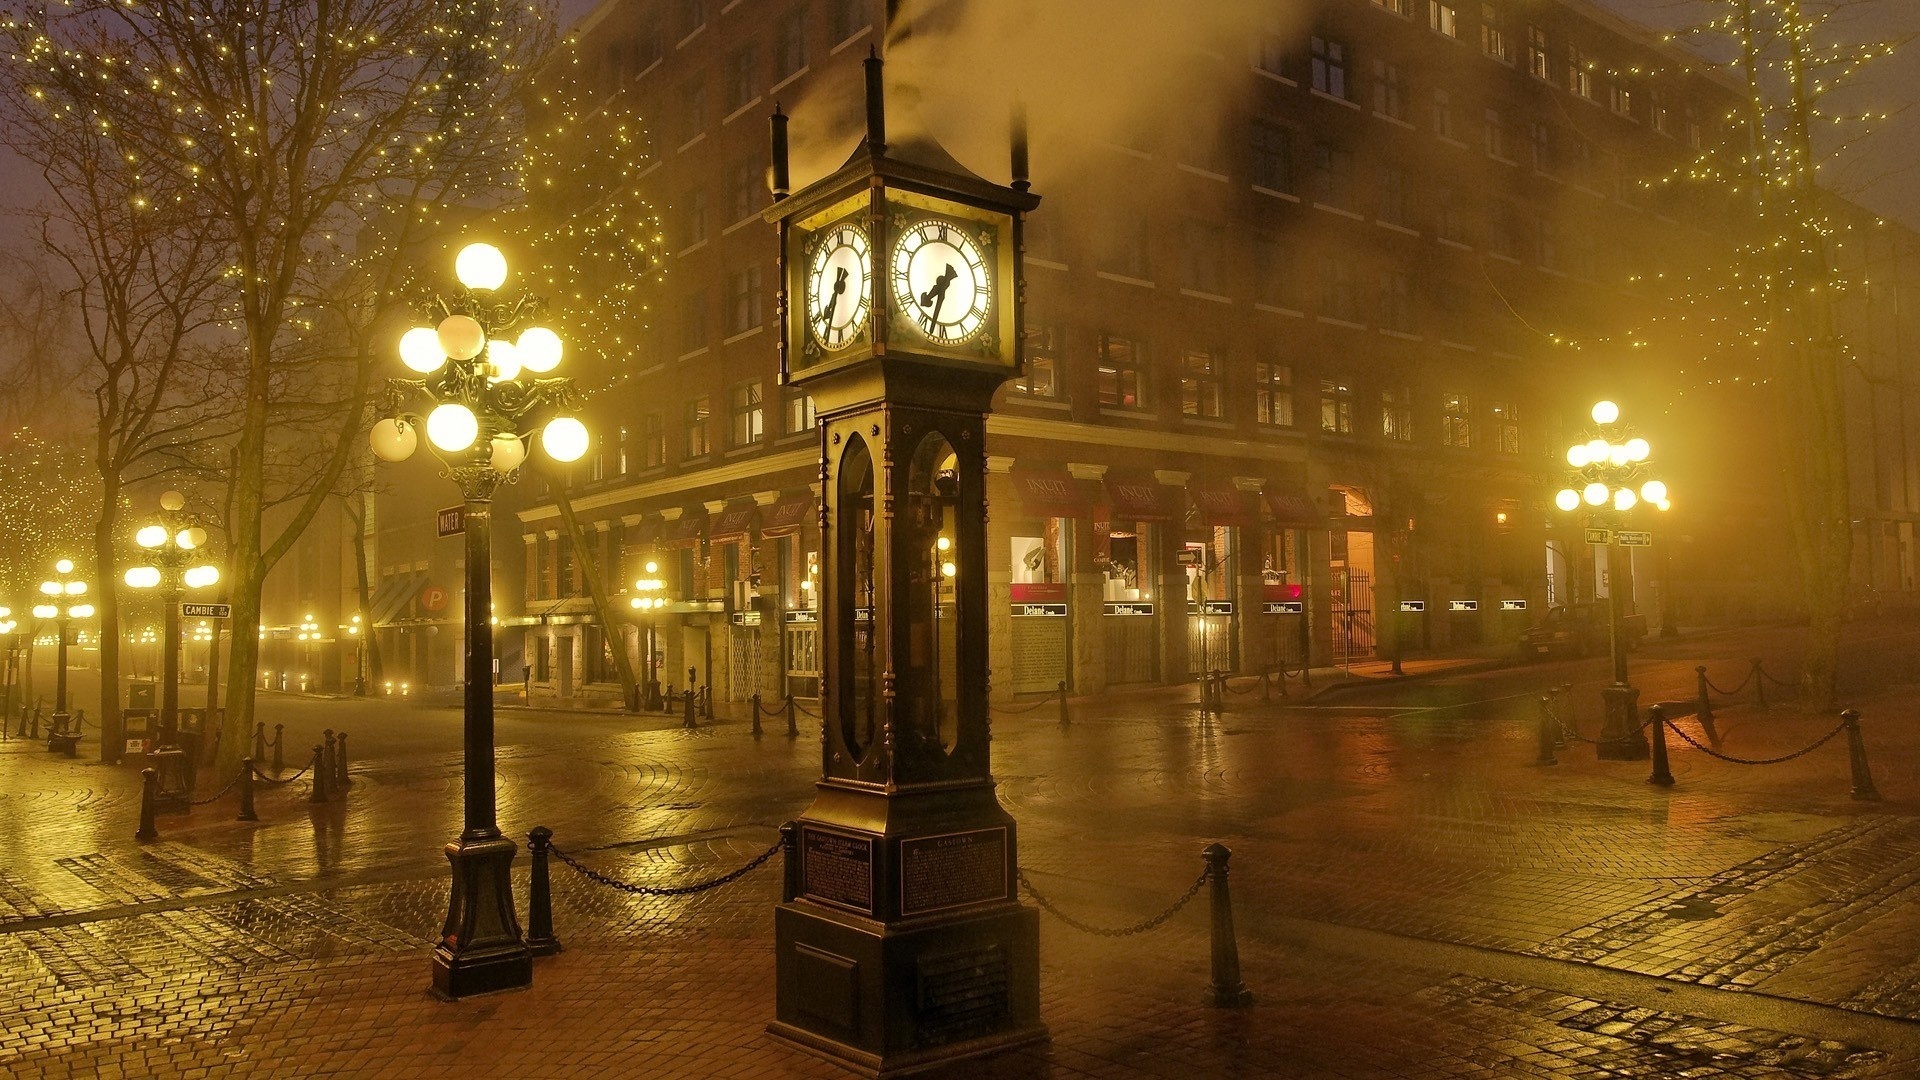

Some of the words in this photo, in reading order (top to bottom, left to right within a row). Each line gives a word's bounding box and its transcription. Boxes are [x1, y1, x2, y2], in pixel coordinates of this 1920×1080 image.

[1026, 478, 1067, 492] INUIT
[440, 511, 459, 532] WATER
[428, 590, 443, 607] P
[185, 605, 214, 616] CAMBIE
[937, 836, 974, 847] GASTOWN
